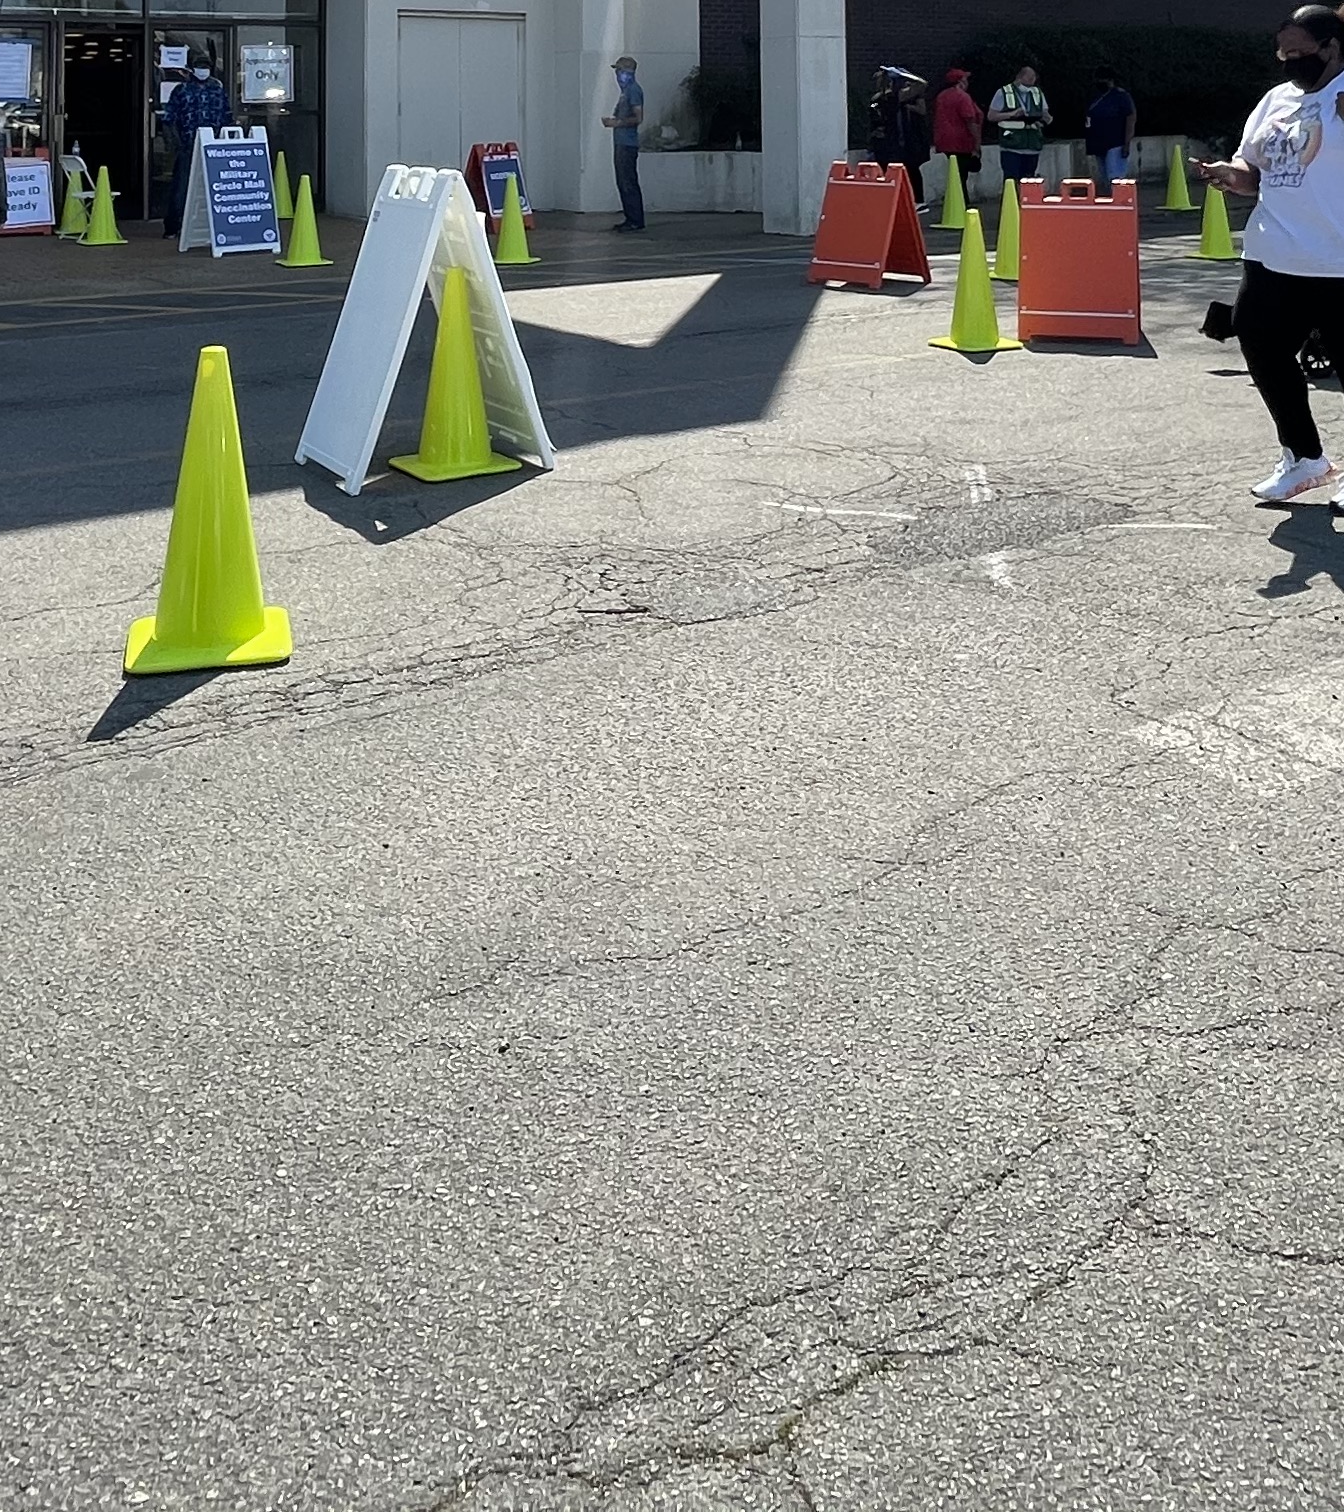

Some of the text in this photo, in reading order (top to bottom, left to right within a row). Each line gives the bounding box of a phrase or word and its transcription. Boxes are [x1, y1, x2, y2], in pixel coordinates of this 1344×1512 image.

[255, 69, 280, 81] Only
[207, 147, 264, 158] Welcome to
[228, 159, 246, 168] the
[7, 174, 35, 182] lease
[219, 170, 258, 180] Military
[212, 180, 265, 191] Circle Mall
[6, 186, 41, 198] ave ID
[213, 191, 270, 202] Community
[213, 202, 272, 214] Vaccination
[227, 214, 262, 224] Center
